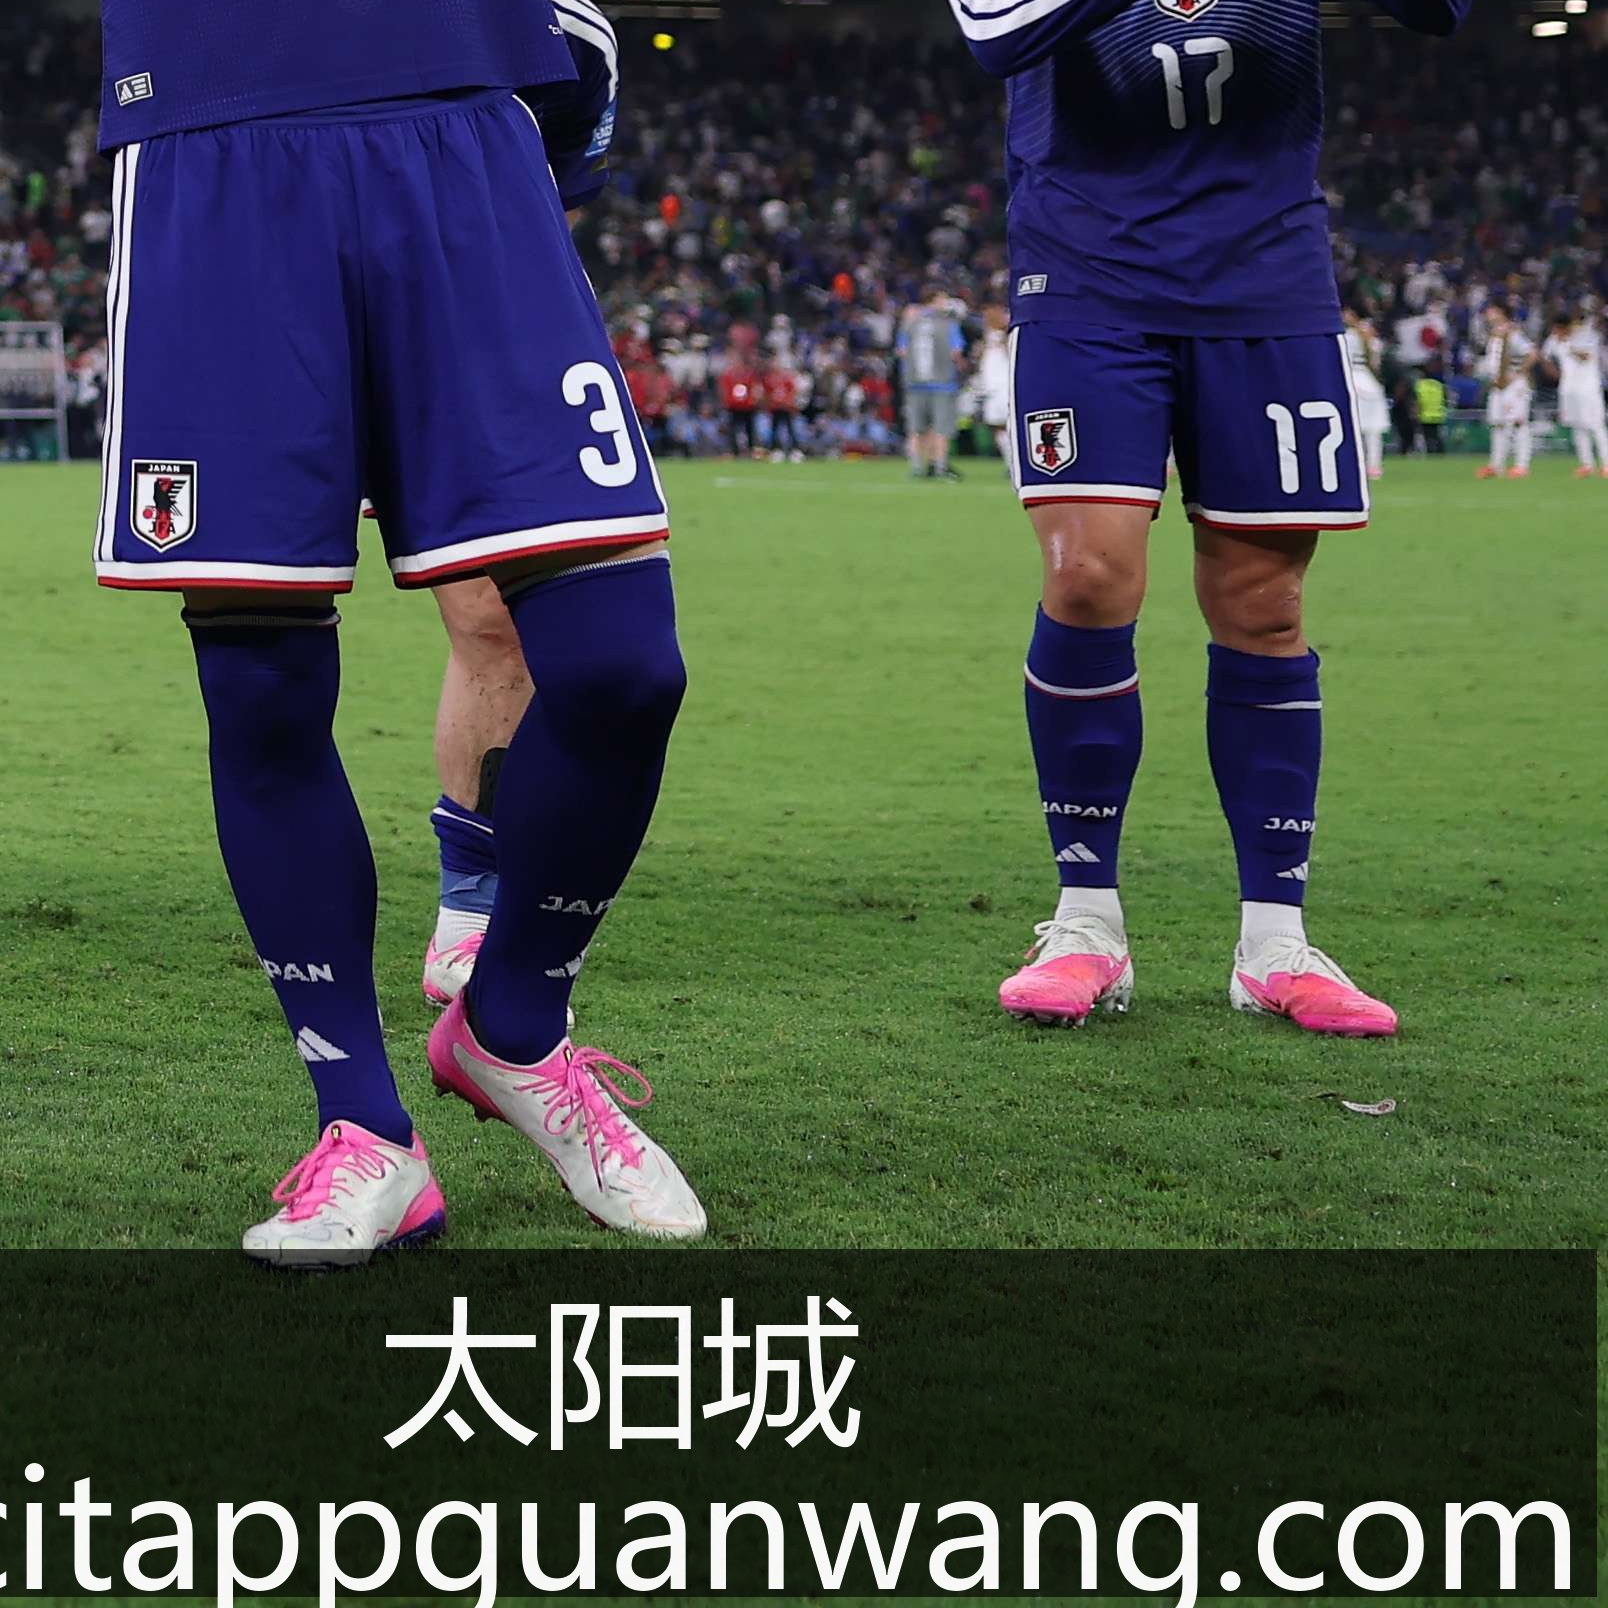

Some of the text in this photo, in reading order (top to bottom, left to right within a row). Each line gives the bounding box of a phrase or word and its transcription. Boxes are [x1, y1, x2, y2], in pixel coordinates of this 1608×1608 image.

[1152, 37, 1234, 130] 17
[560, 361, 638, 488] 3
[1265, 400, 1345, 494] 17
[147, 464, 181, 473] JAPAN
[1264, 817, 1316, 833] JAP
[539, 895, 614, 917] JAP
[261, 957, 335, 983] PAN
